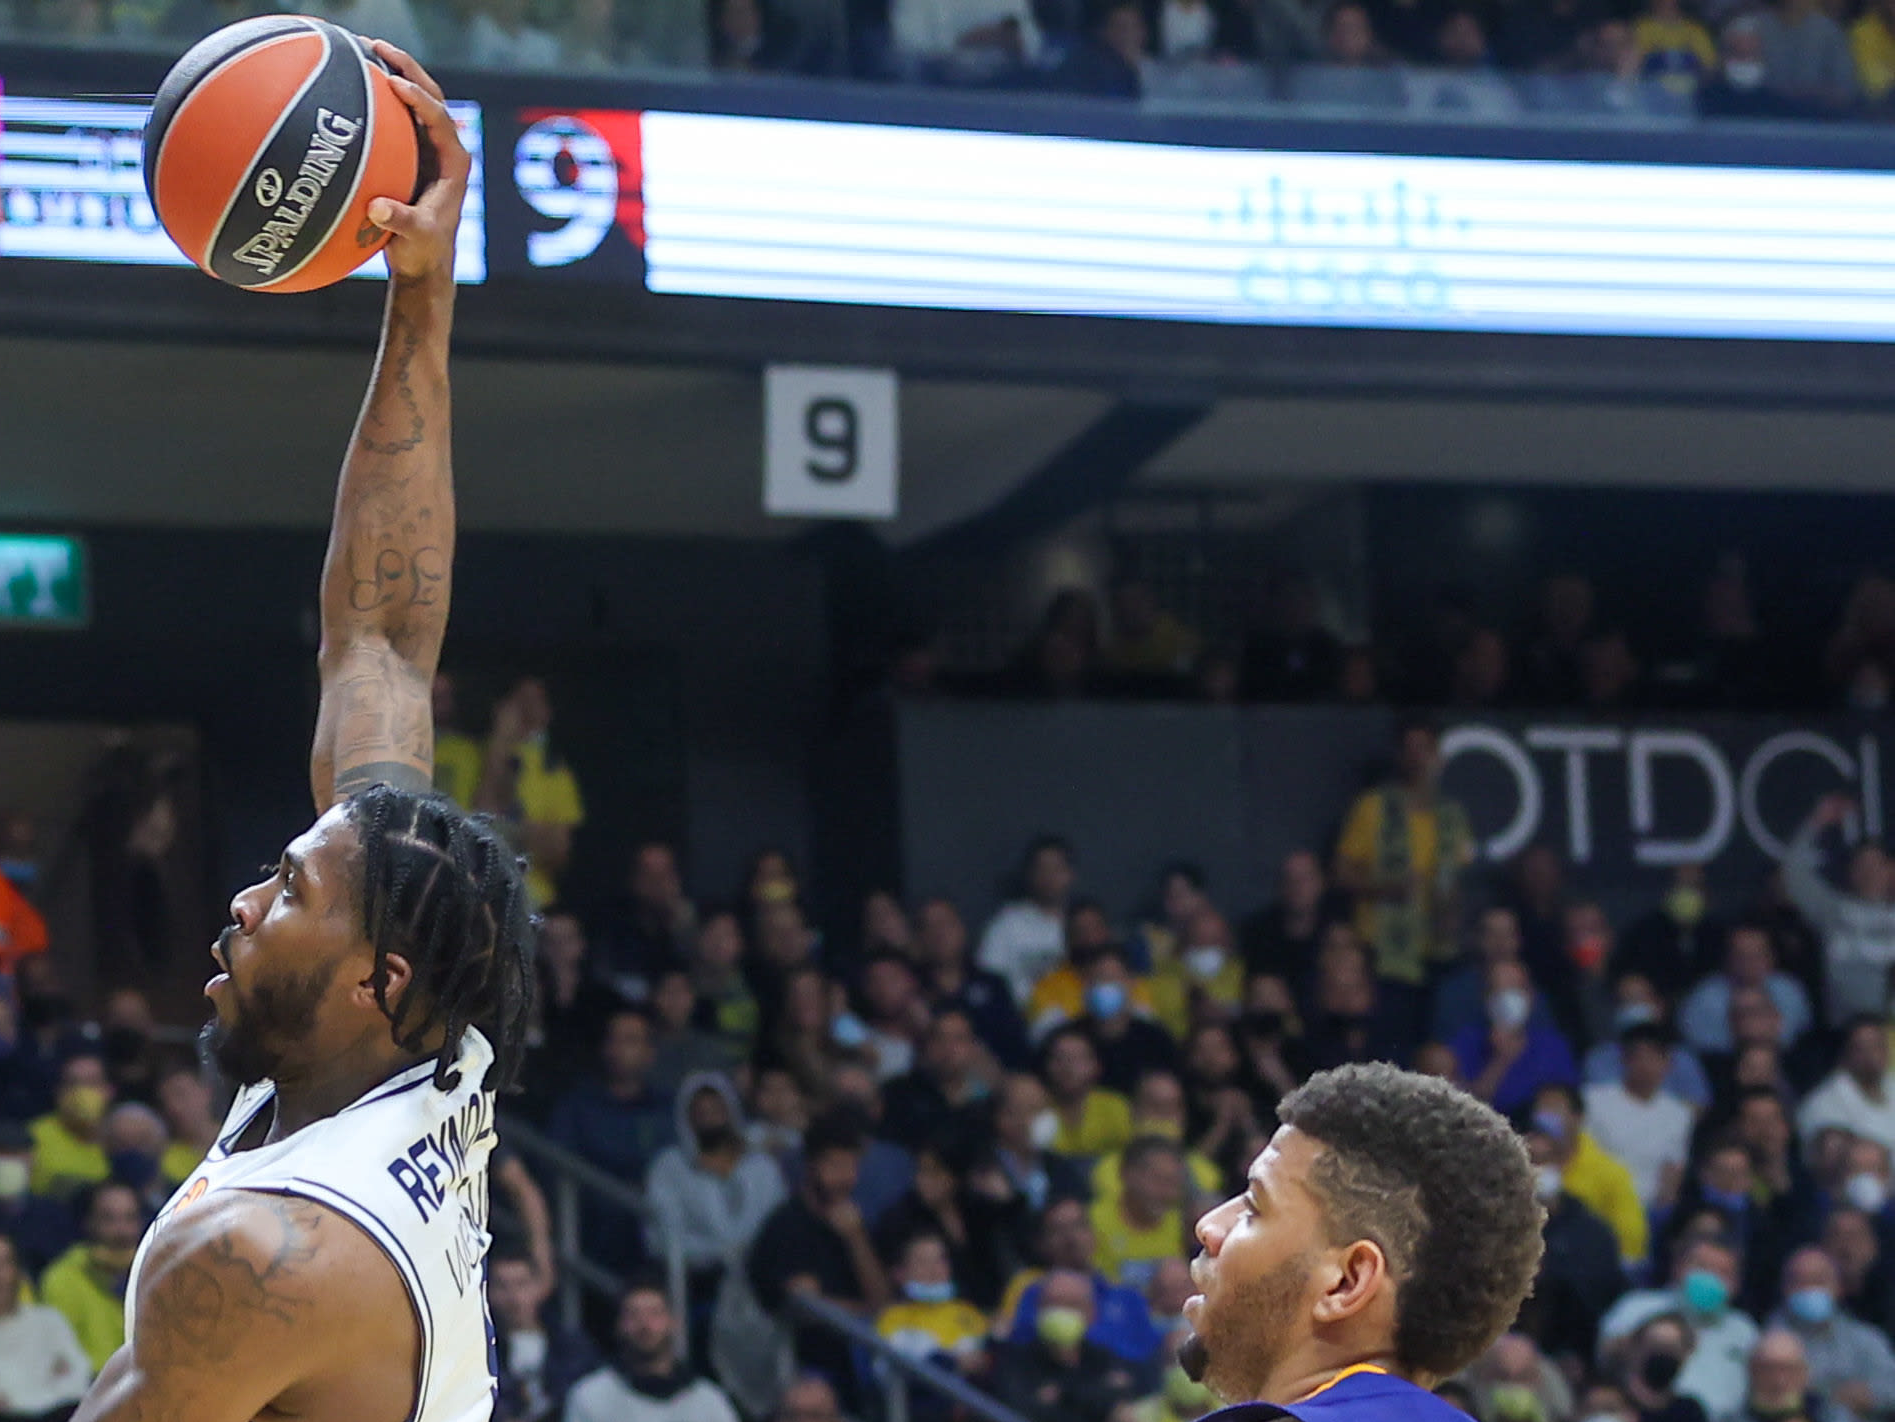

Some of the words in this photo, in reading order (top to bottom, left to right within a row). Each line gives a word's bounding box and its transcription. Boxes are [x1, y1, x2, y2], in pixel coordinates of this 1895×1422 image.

[232, 107, 361, 276] SPALDING
[513, 114, 618, 268] 9
[805, 396, 860, 483] 9
